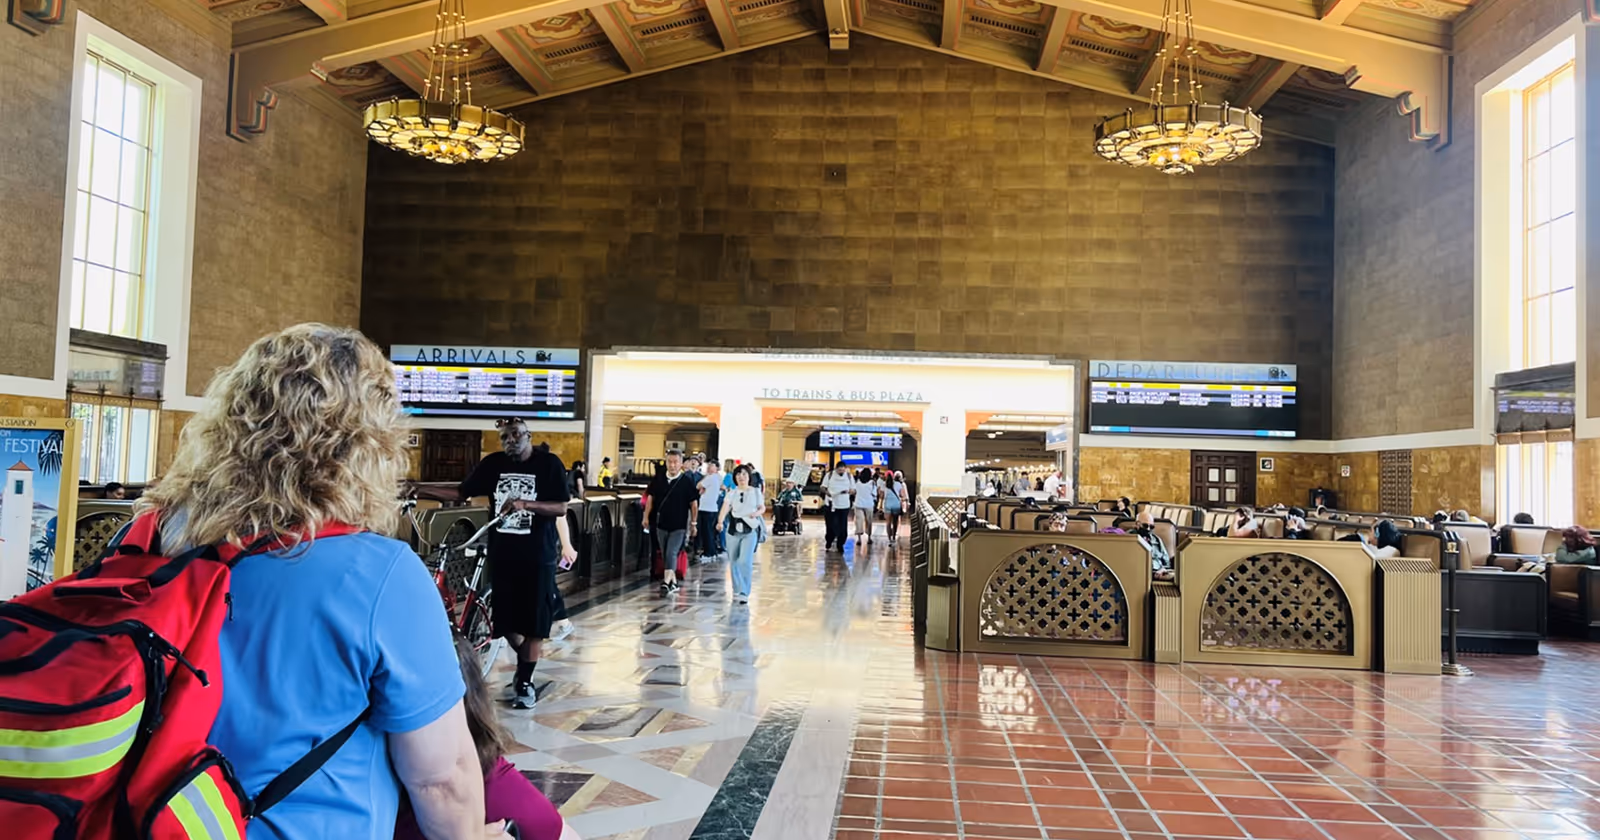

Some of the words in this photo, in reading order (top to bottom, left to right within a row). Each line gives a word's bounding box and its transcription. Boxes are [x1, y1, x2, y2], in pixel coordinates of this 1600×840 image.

[415, 347, 526, 365] ARRIVALS
[762, 388, 781, 399] TO
[785, 388, 833, 400] TRAINS
[837, 390, 846, 400] &
[850, 391, 876, 401] BUS
[880, 391, 924, 402] PLAZA
[5, 419, 37, 427] STATION
[4, 438, 64, 454] FESTIVAL
